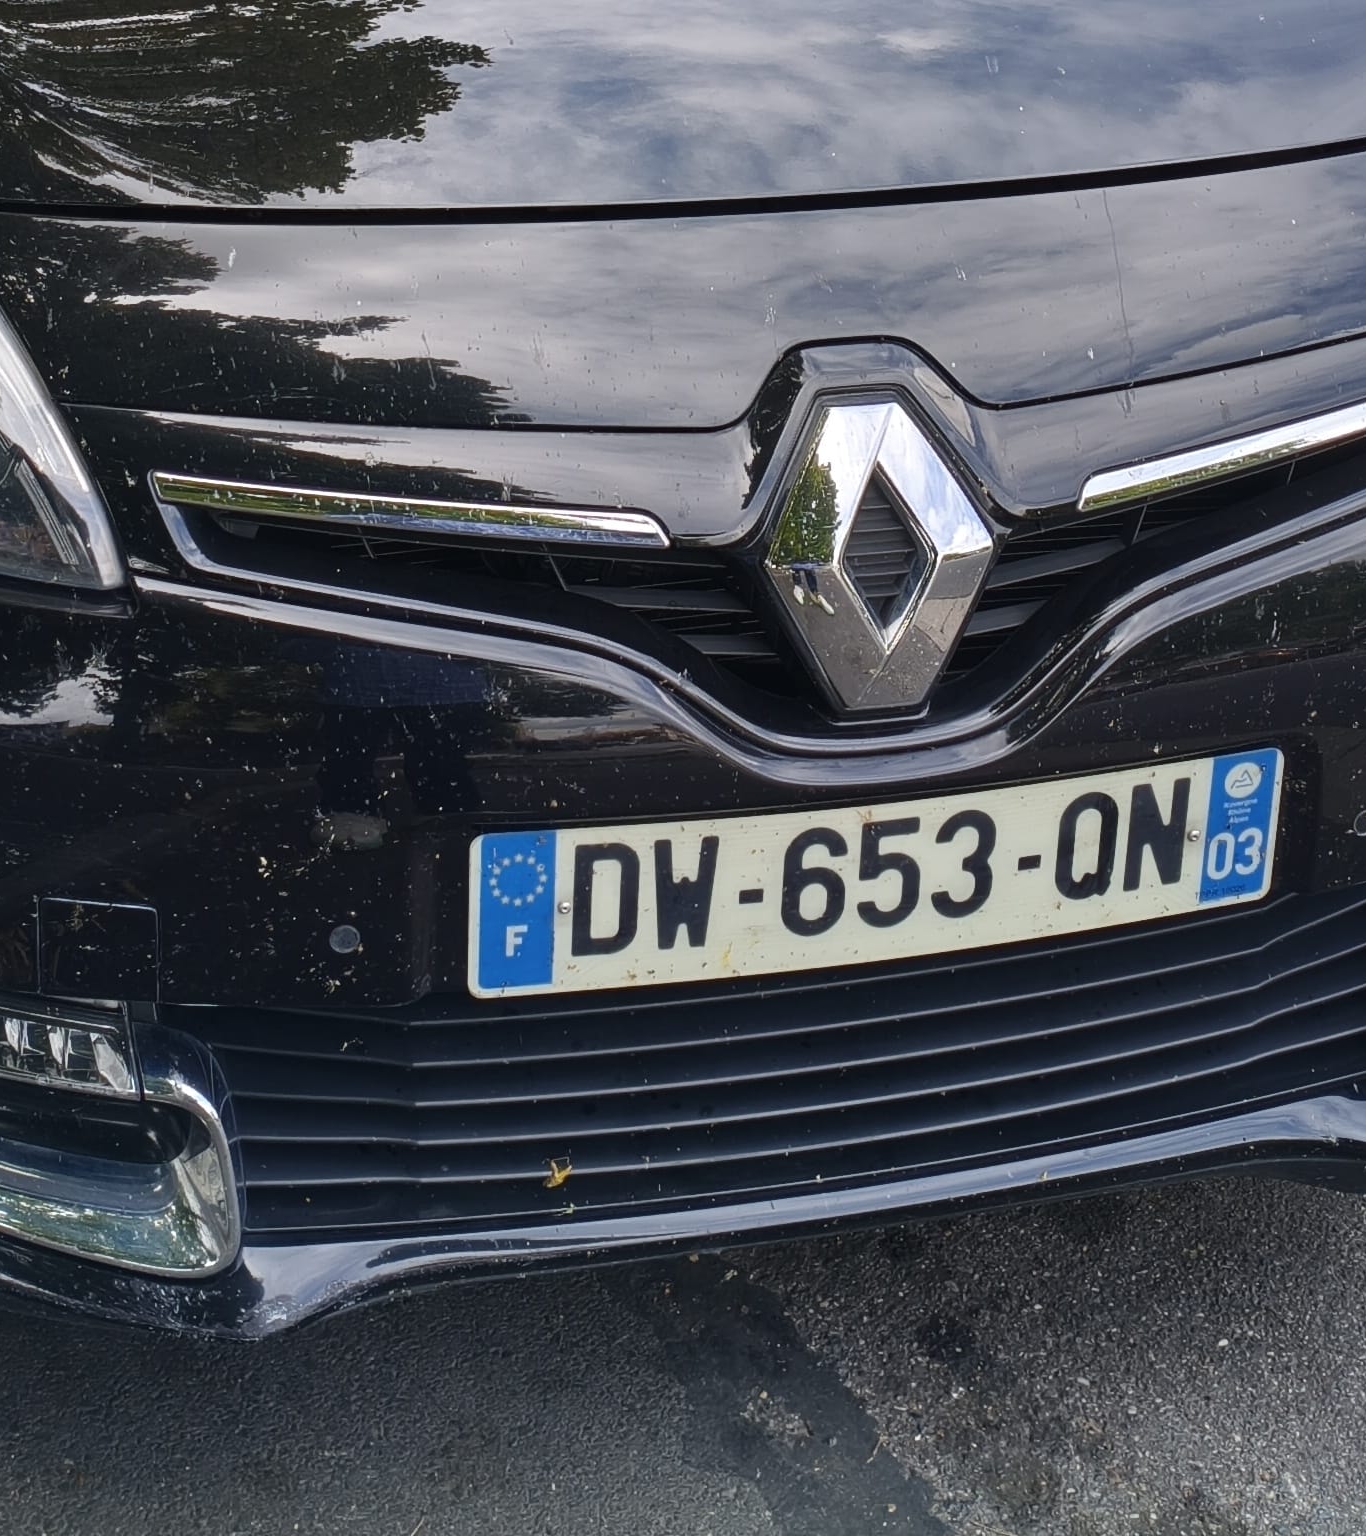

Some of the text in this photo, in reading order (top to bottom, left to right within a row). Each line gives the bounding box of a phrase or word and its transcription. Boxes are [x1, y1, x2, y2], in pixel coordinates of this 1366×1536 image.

[570, 777, 1191, 957] DW-653-QN
[1207, 827, 1263, 880] 03
[505, 924, 528, 957] F
